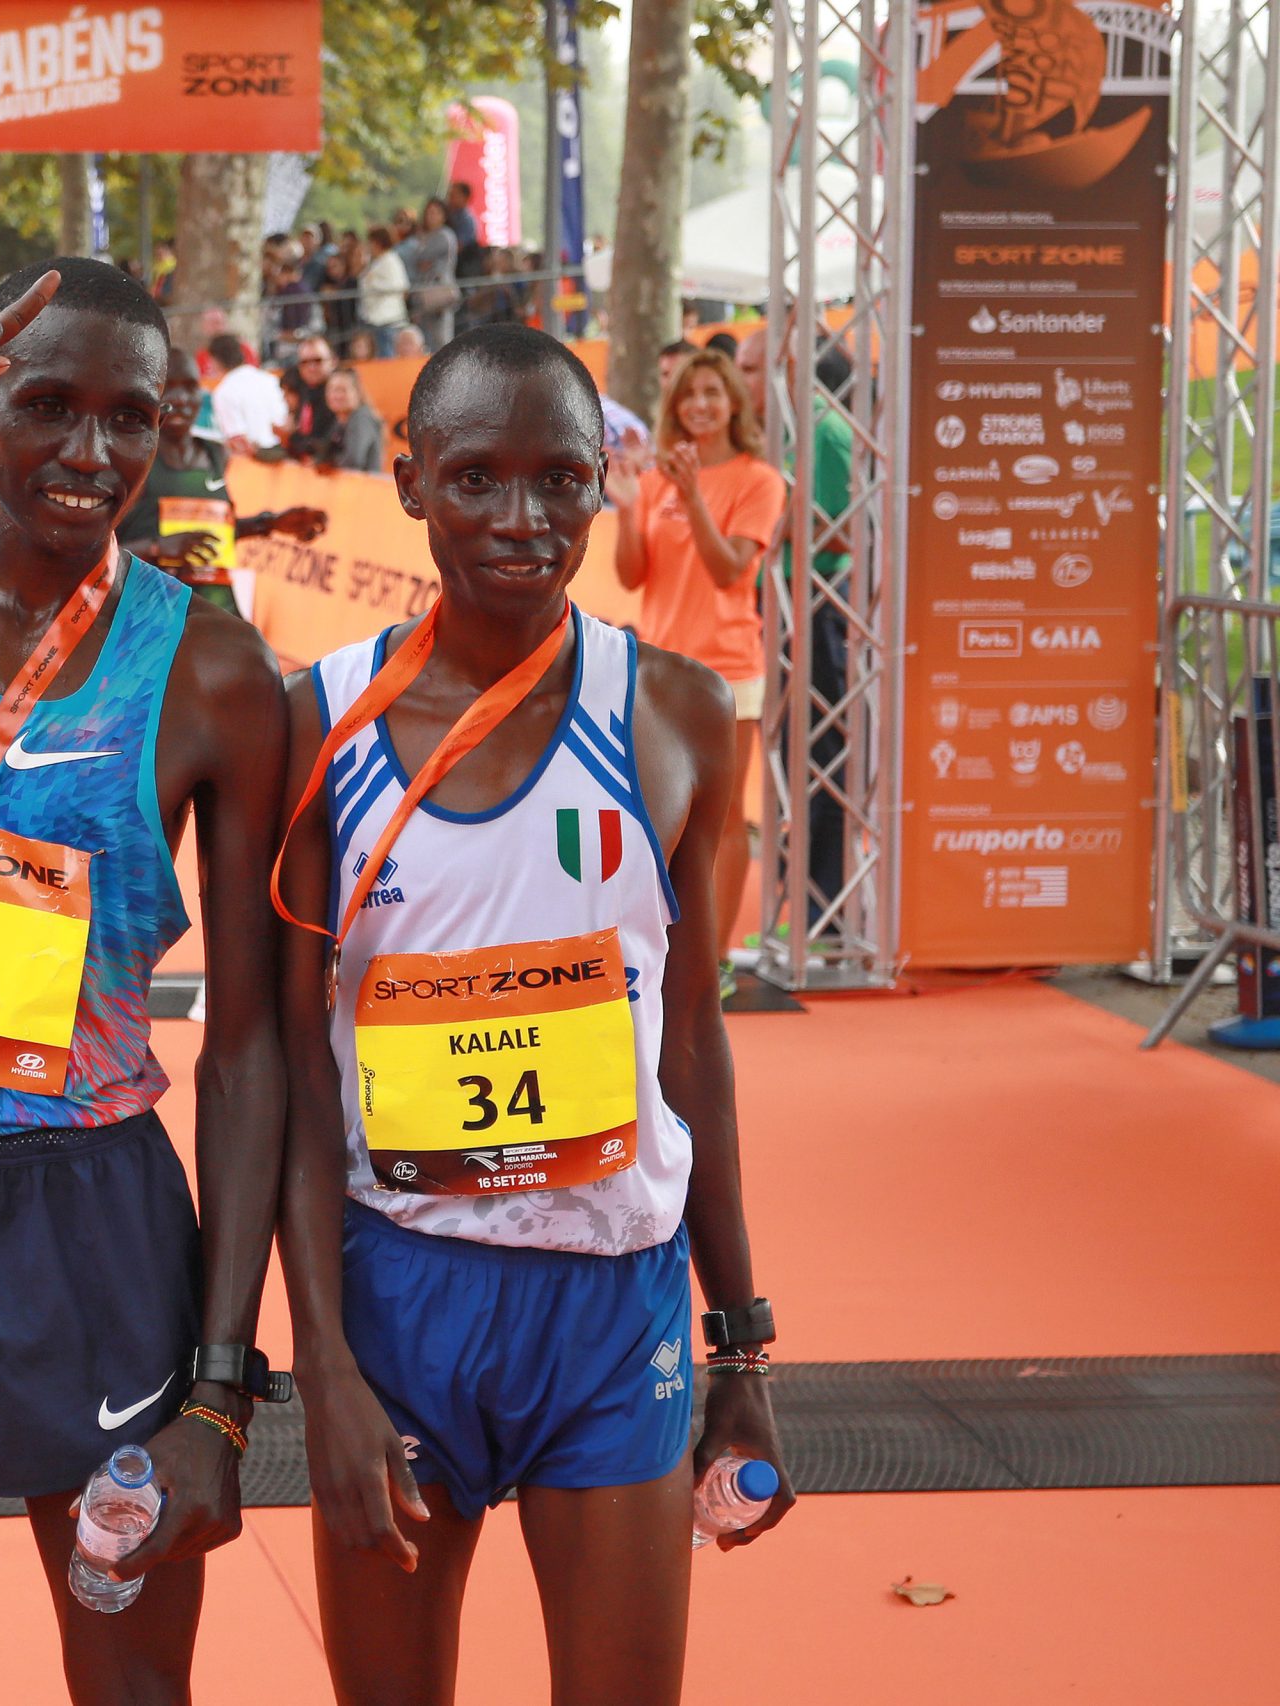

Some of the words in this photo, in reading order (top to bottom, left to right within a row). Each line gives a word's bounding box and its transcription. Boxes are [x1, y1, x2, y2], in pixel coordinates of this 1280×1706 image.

[183, 53, 294, 73] SPORT
[184, 75, 293, 96] ZONE
[954, 245, 1037, 265] SPORT
[1040, 245, 1124, 265] ZONE
[998, 310, 1107, 334] Santander
[968, 382, 1042, 399] HYUNDAI
[1030, 626, 1102, 649] GAIA
[10, 679, 34, 714] SPORT
[32, 645, 59, 679] ZONE
[360, 886, 405, 909] rrea
[374, 975, 480, 1000] SPORT
[488, 958, 606, 993] ZONE
[449, 1026, 541, 1056] KALALE
[11, 1068, 47, 1079] HYUNDAI
[366, 1075, 374, 1116] LIDERGRAF
[457, 1069, 546, 1131] 34
[504, 1155, 520, 1163] MEIA
[521, 1152, 557, 1162] MARATONA
[599, 1152, 626, 1166] HYUNDAI
[477, 1177, 491, 1189] 16
[492, 1175, 518, 1187] SET
[518, 1172, 547, 1185] 2018
